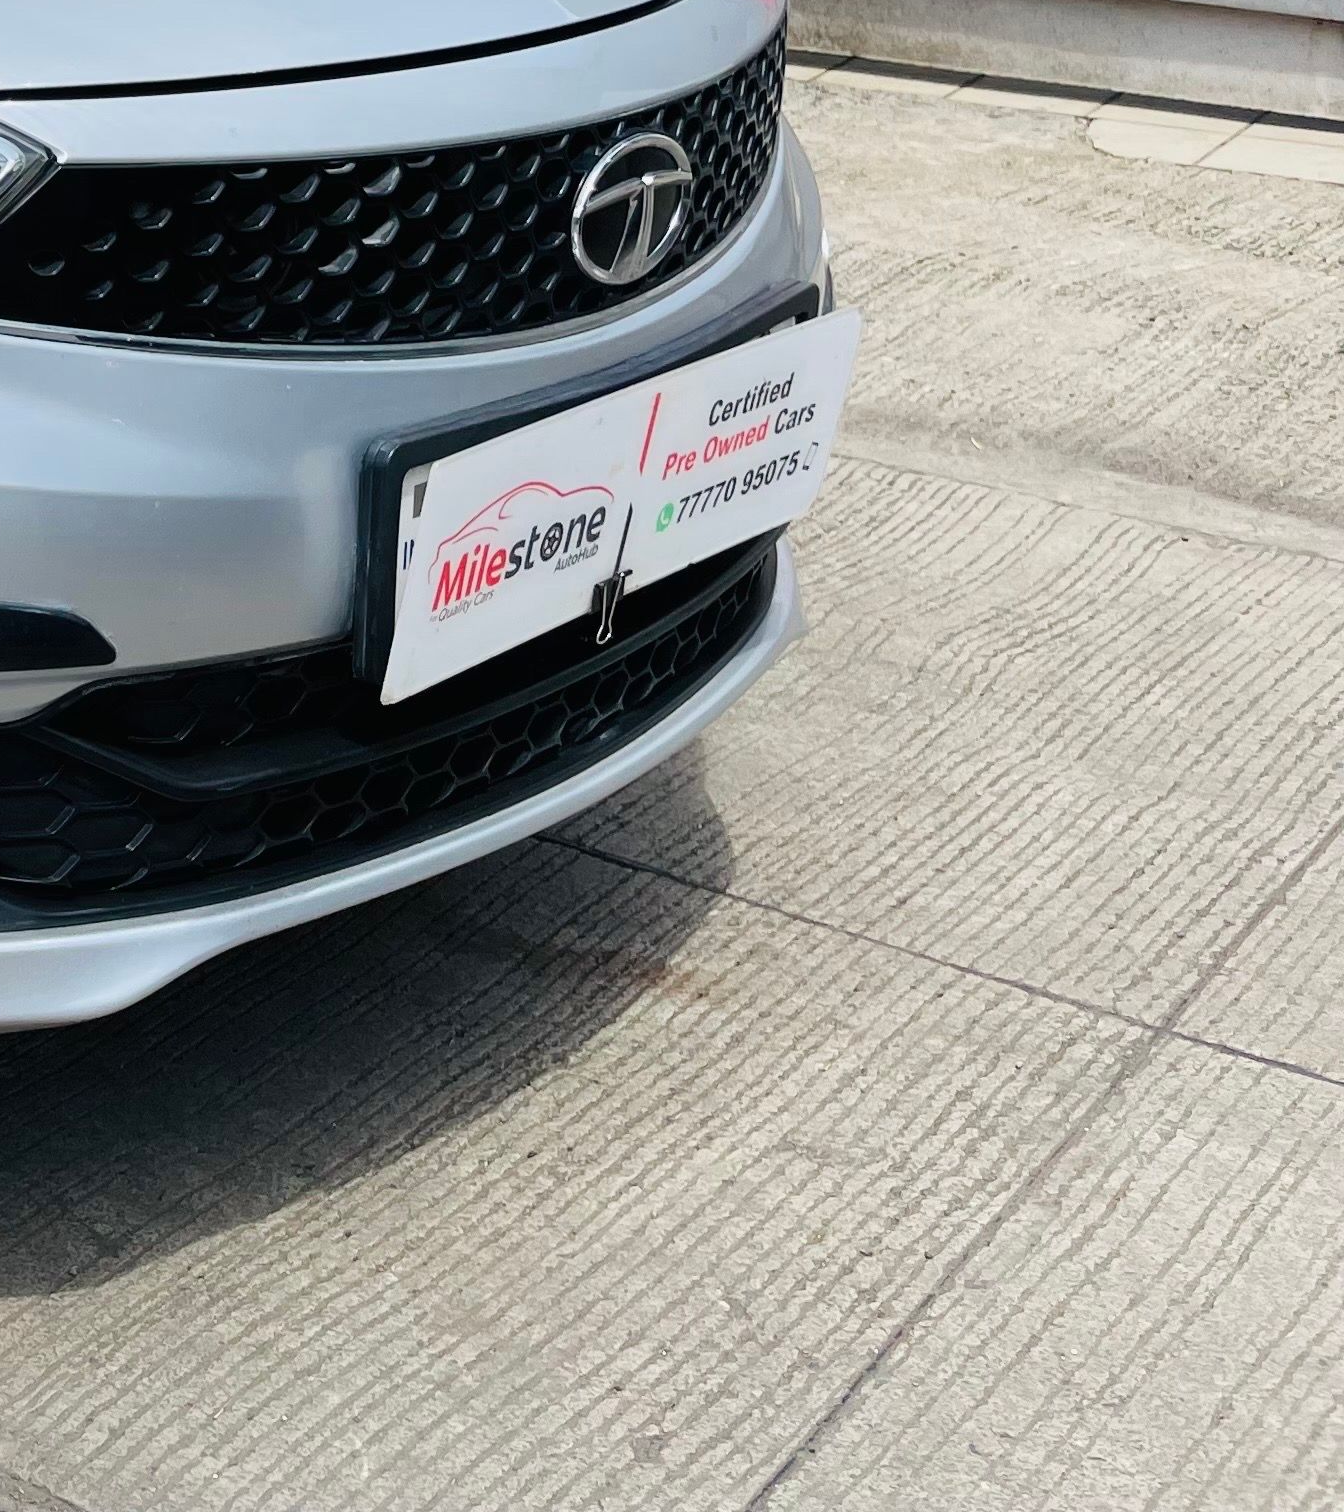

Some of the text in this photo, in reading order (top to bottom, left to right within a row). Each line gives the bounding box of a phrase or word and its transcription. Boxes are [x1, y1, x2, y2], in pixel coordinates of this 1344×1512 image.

[709, 372, 795, 426] Certified
[662, 403, 816, 480] Pre Owned Cars
[676, 450, 800, 523] 77770 95075
[432, 506, 606, 612] Milestone
[554, 544, 599, 573] AutoHub
[439, 600, 472, 621] Quality
[474, 590, 494, 606] Cars
